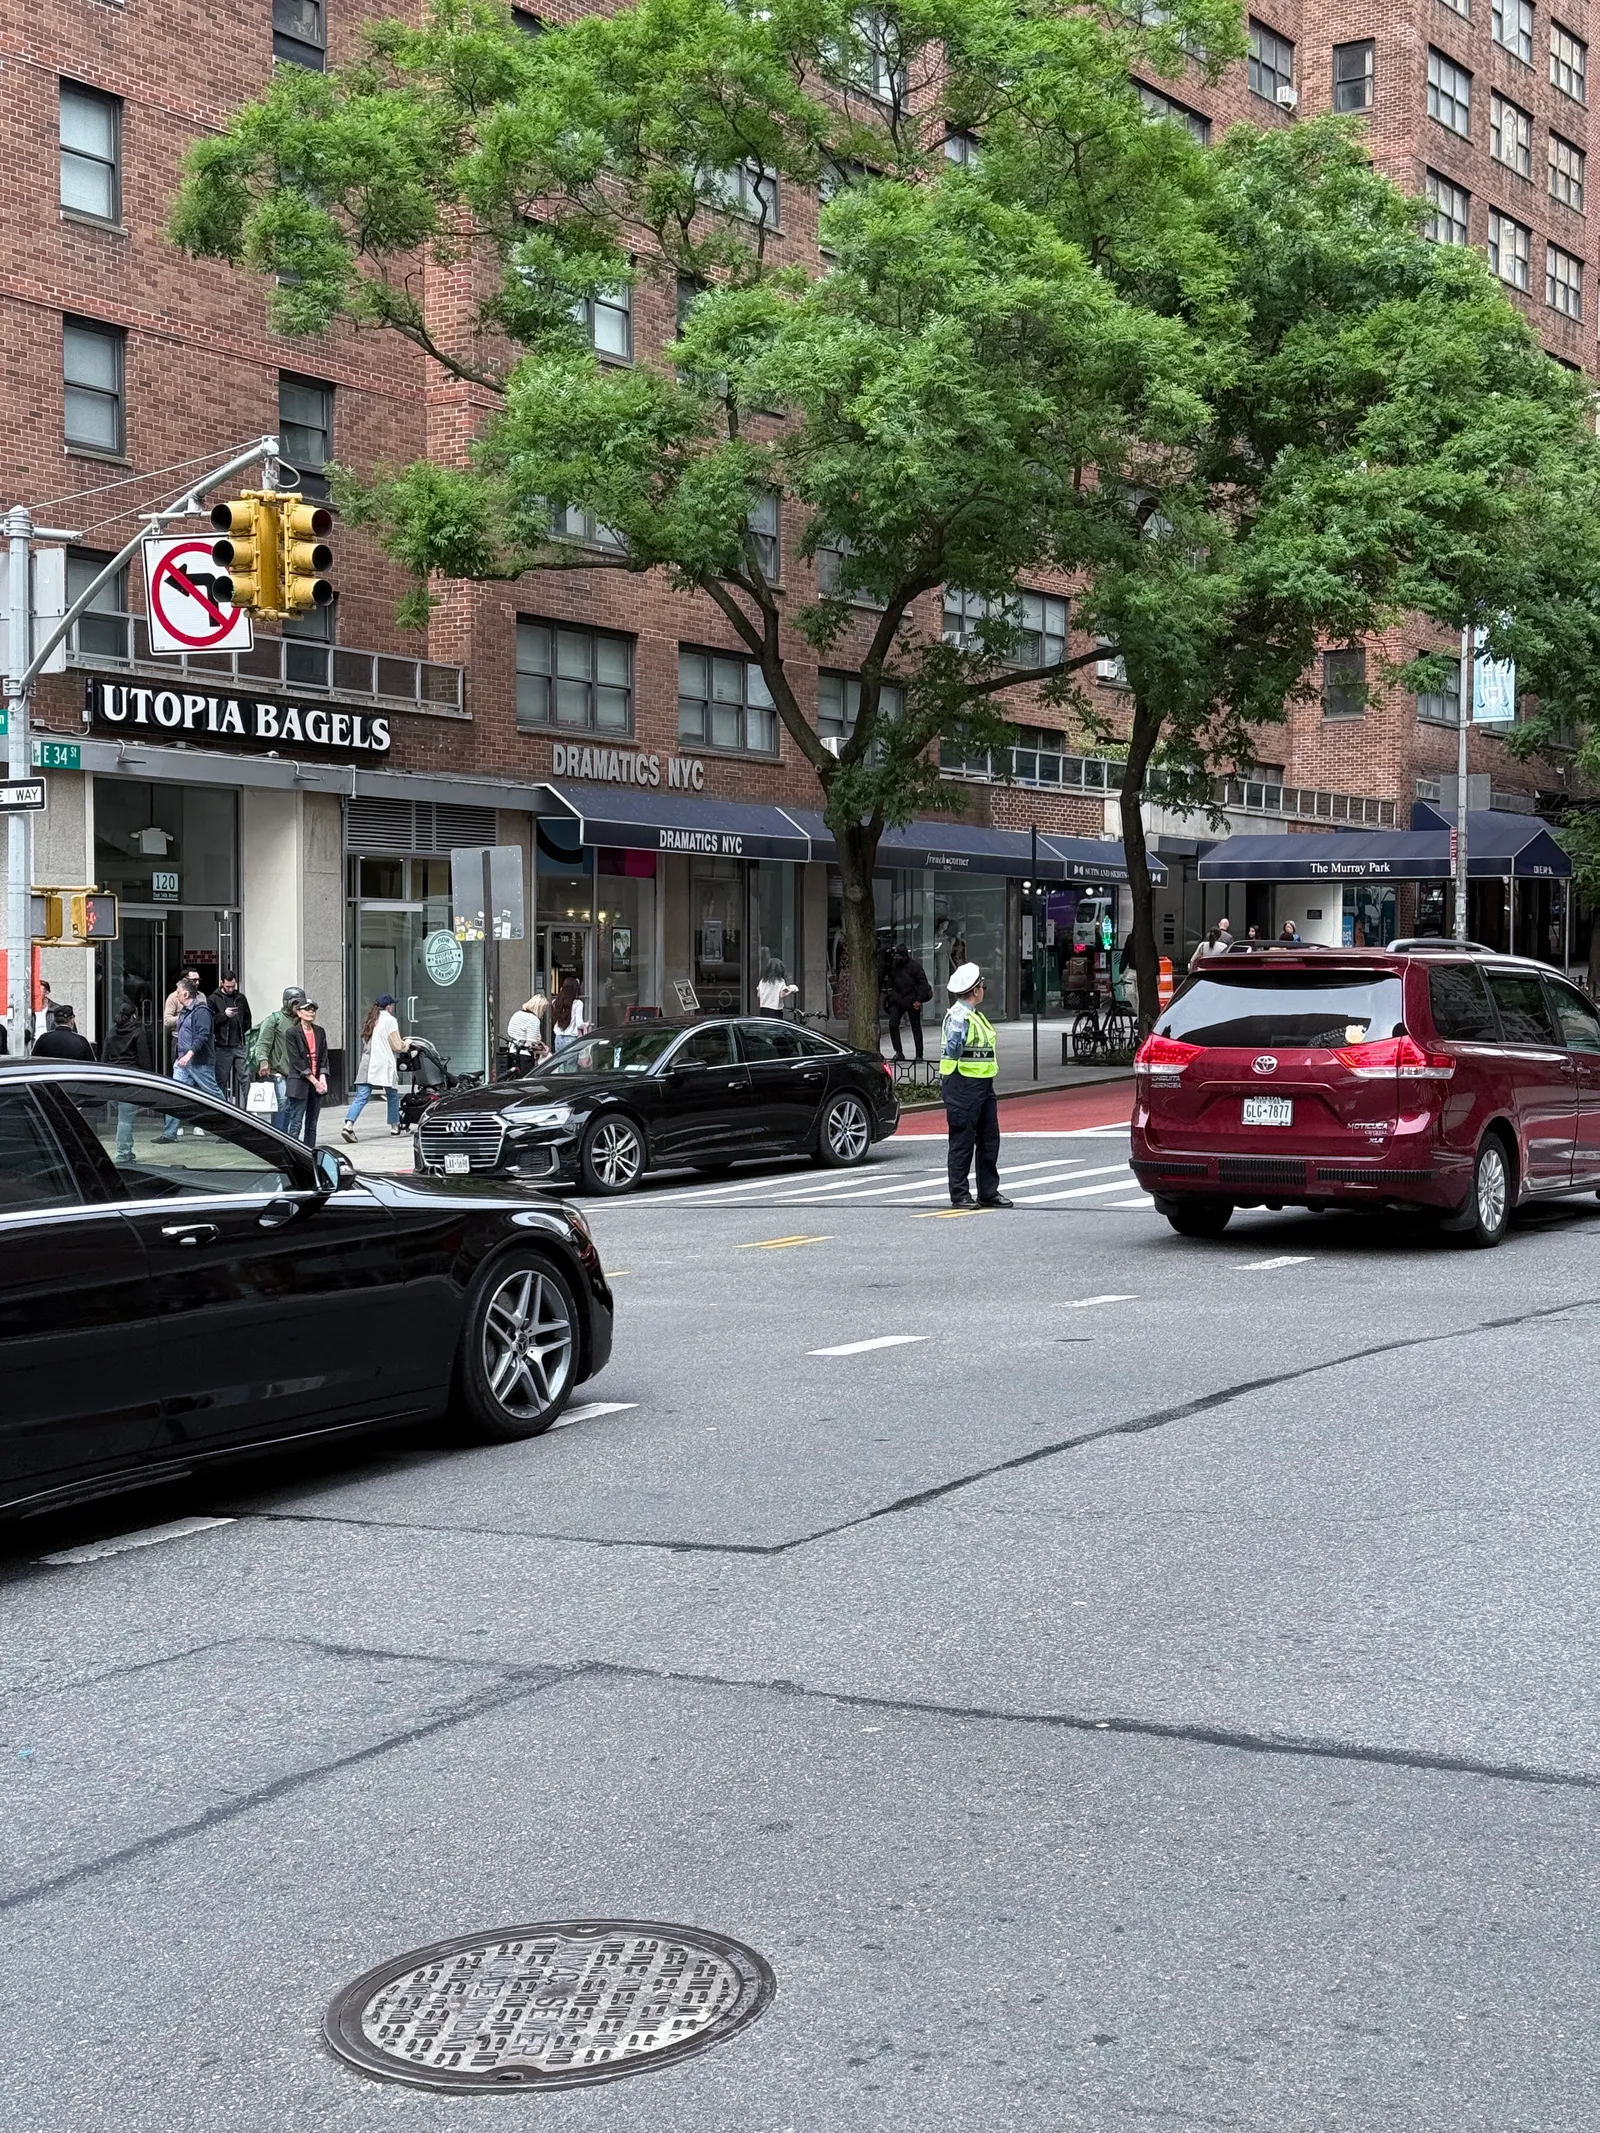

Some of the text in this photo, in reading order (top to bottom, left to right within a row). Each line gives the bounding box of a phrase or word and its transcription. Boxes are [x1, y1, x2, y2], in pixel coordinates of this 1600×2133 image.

[102, 684, 391, 751] UTOPIA BAGELS
[43, 745, 50, 763] E
[53, 746, 68, 765] 34
[70, 746, 77, 758] St
[552, 743, 704, 790] DRAMATICS NYC
[15, 788, 39, 801] WAY
[659, 829, 743, 854] DRAMATICS NYC
[1100, 869, 1110, 878] AND
[1310, 862, 1390, 875] The Murray Park
[155, 874, 175, 890] 120
[437, 936, 450, 945] NOW
[434, 951, 453, 960] UTOPIA
[434, 956, 454, 965] BAGELS
[1246, 1104, 1289, 1119] GLG 7877
